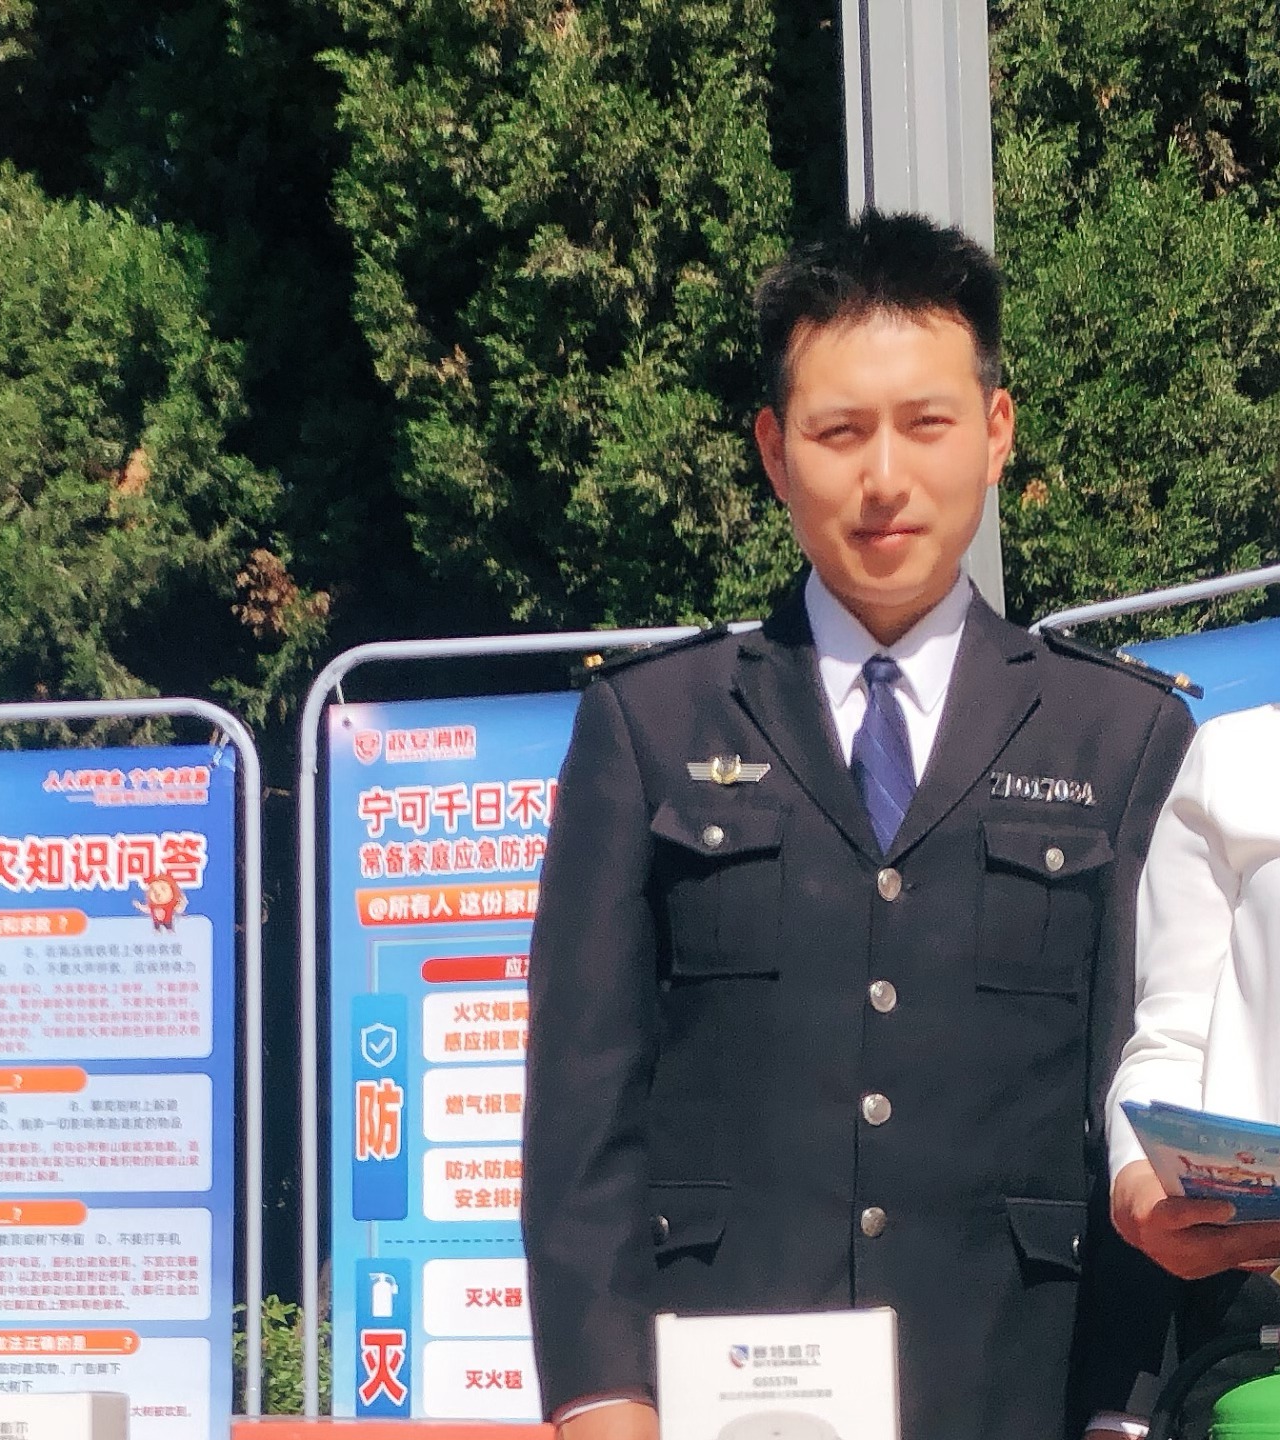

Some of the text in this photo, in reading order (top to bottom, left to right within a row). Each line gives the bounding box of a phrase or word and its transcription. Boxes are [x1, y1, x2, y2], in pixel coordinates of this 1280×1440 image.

[368, 894, 453, 920] @所有人
[359, 1081, 402, 1159] 防
[465, 1287, 524, 1308] 灭火器
[361, 1332, 405, 1402] 灭
[465, 1369, 524, 1390] 灭火毯
